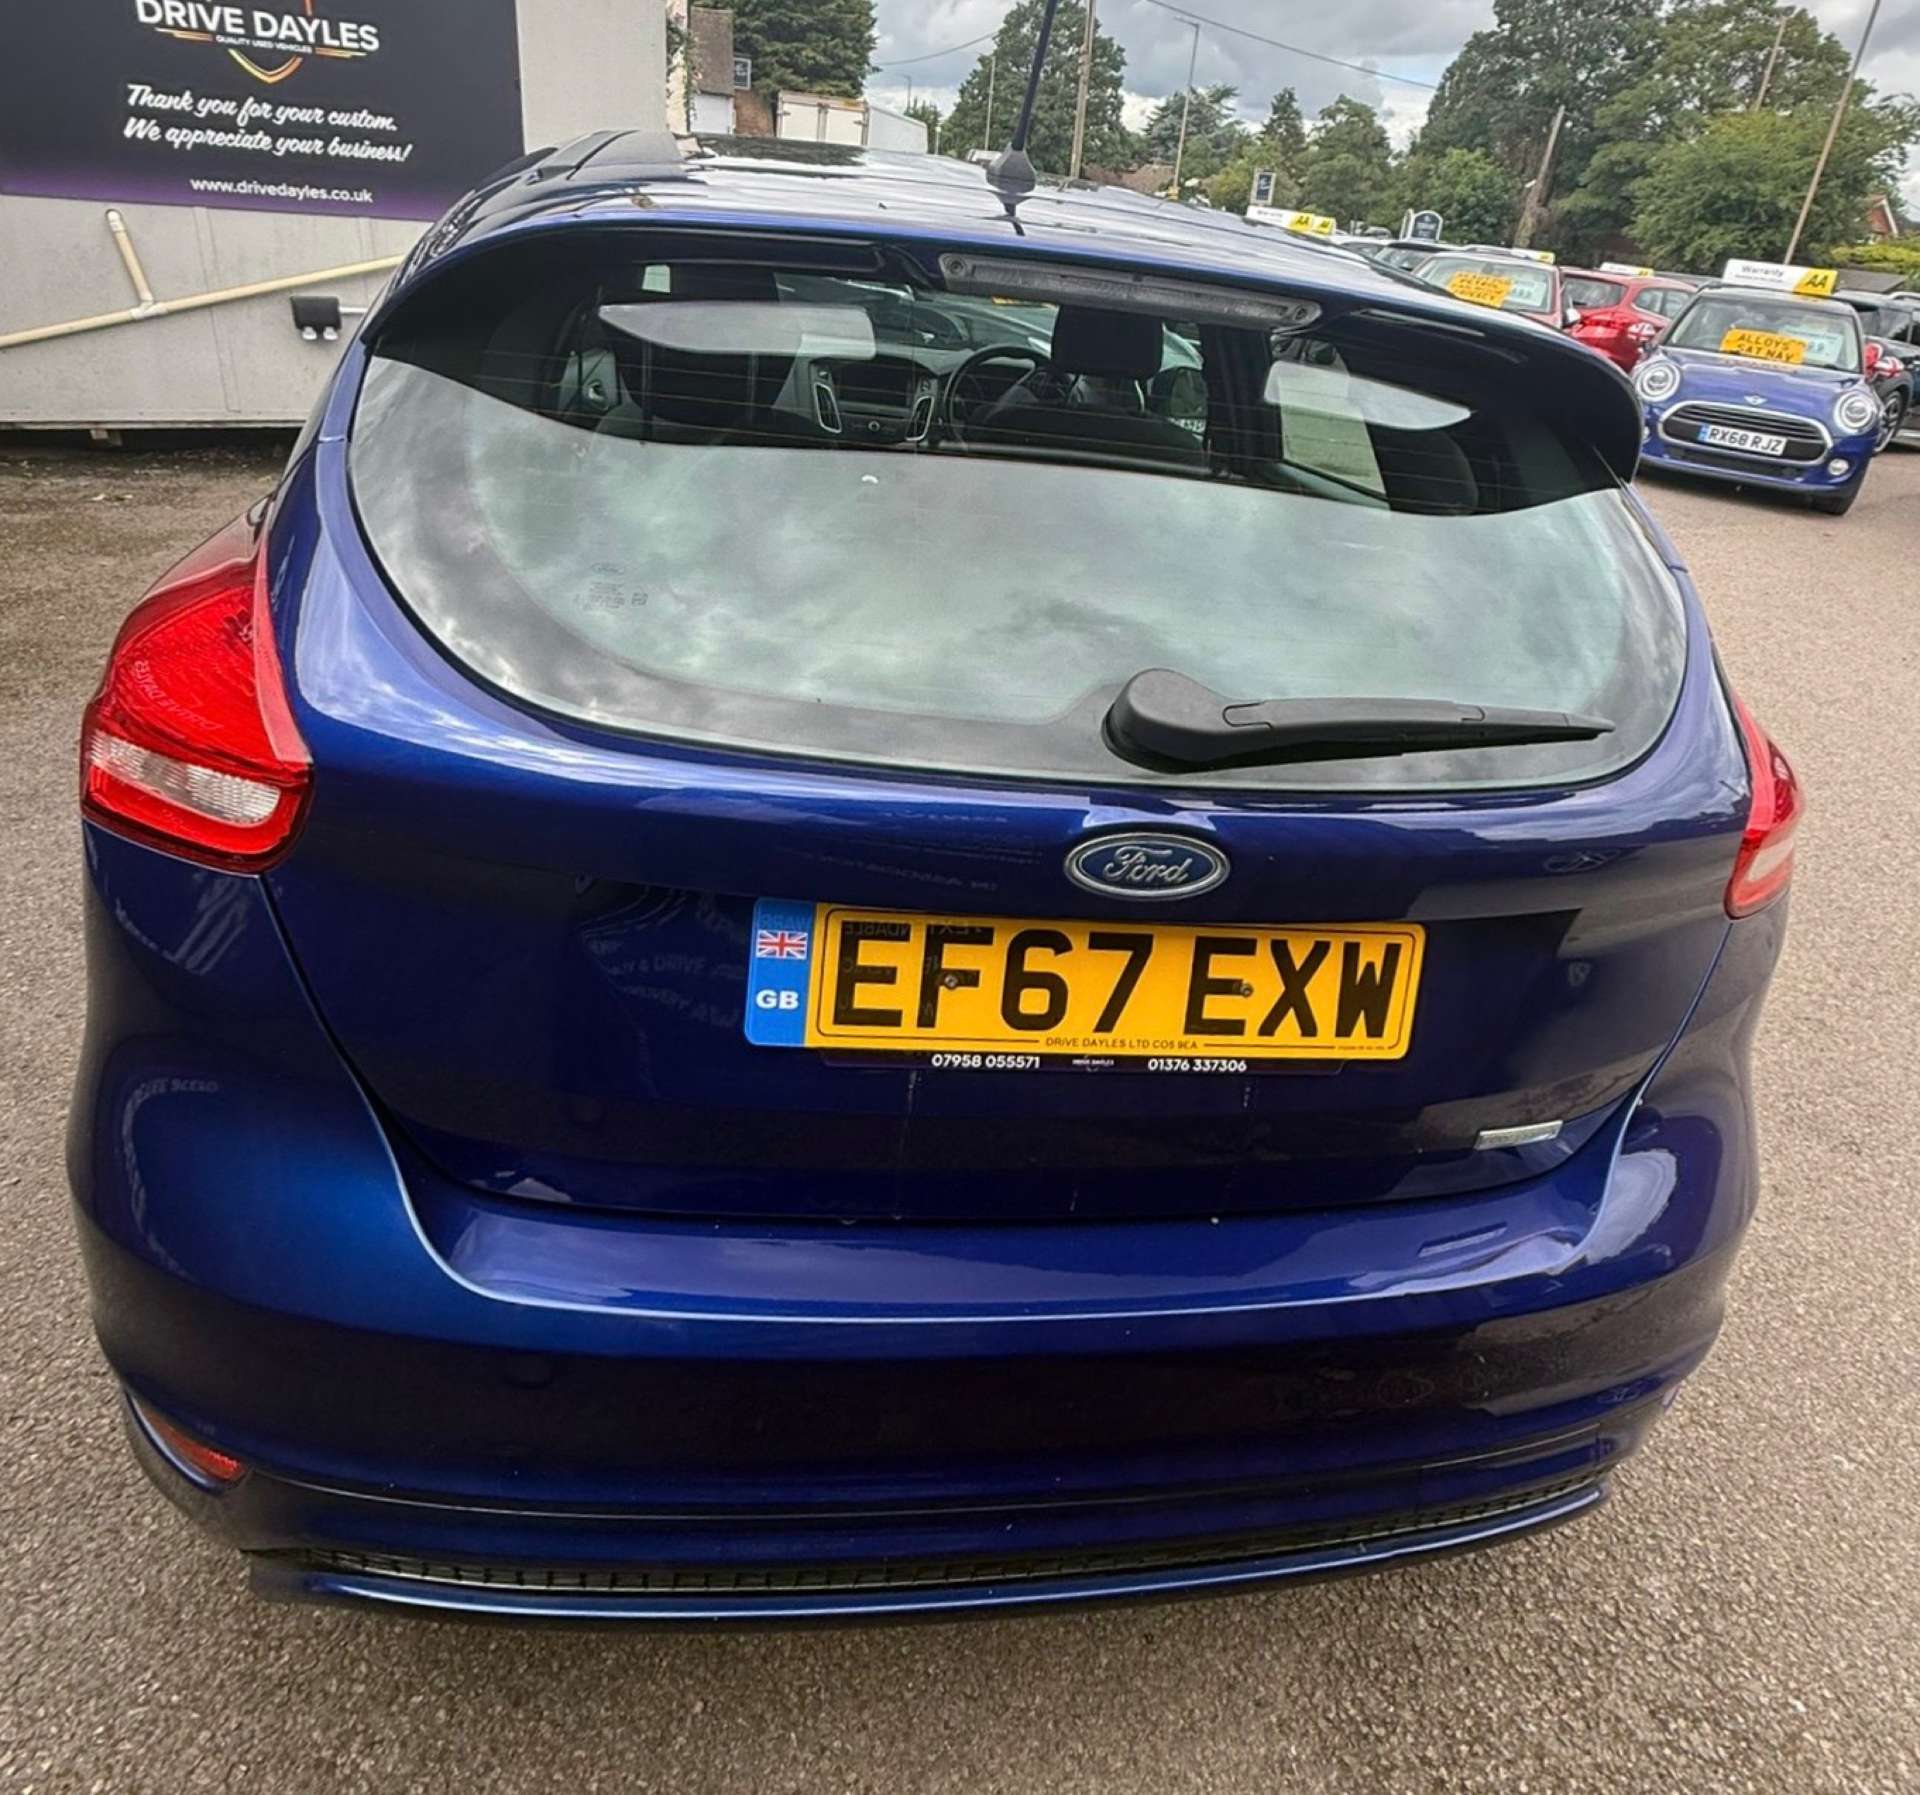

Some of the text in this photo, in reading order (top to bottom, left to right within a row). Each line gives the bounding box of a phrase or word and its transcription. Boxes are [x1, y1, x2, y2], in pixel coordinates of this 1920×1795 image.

[136, 0, 380, 51] DRIVE DAYLES
[127, 83, 399, 131] Thank you for your custom.
[123, 116, 414, 162] We appreciate your business!
[190, 179, 373, 203] www.drivedayles.co.uk
[1804, 273, 1829, 289] AA
[1736, 332, 1790, 351] ALLOYS
[1709, 428, 1783, 453] RX68 RJZ
[1103, 846, 1193, 883] Ford
[831, 919, 1403, 1039] EF67 EXW
[756, 989, 799, 1010] GB
[1045, 1037, 1079, 1047] DRIVE
[1082, 1038, 1127, 1048] DAYLES
[1128, 1039, 1150, 1049] LTD
[931, 1054, 1041, 1069] 07958 055571
[1148, 1059, 1248, 1072] 01376 337306
